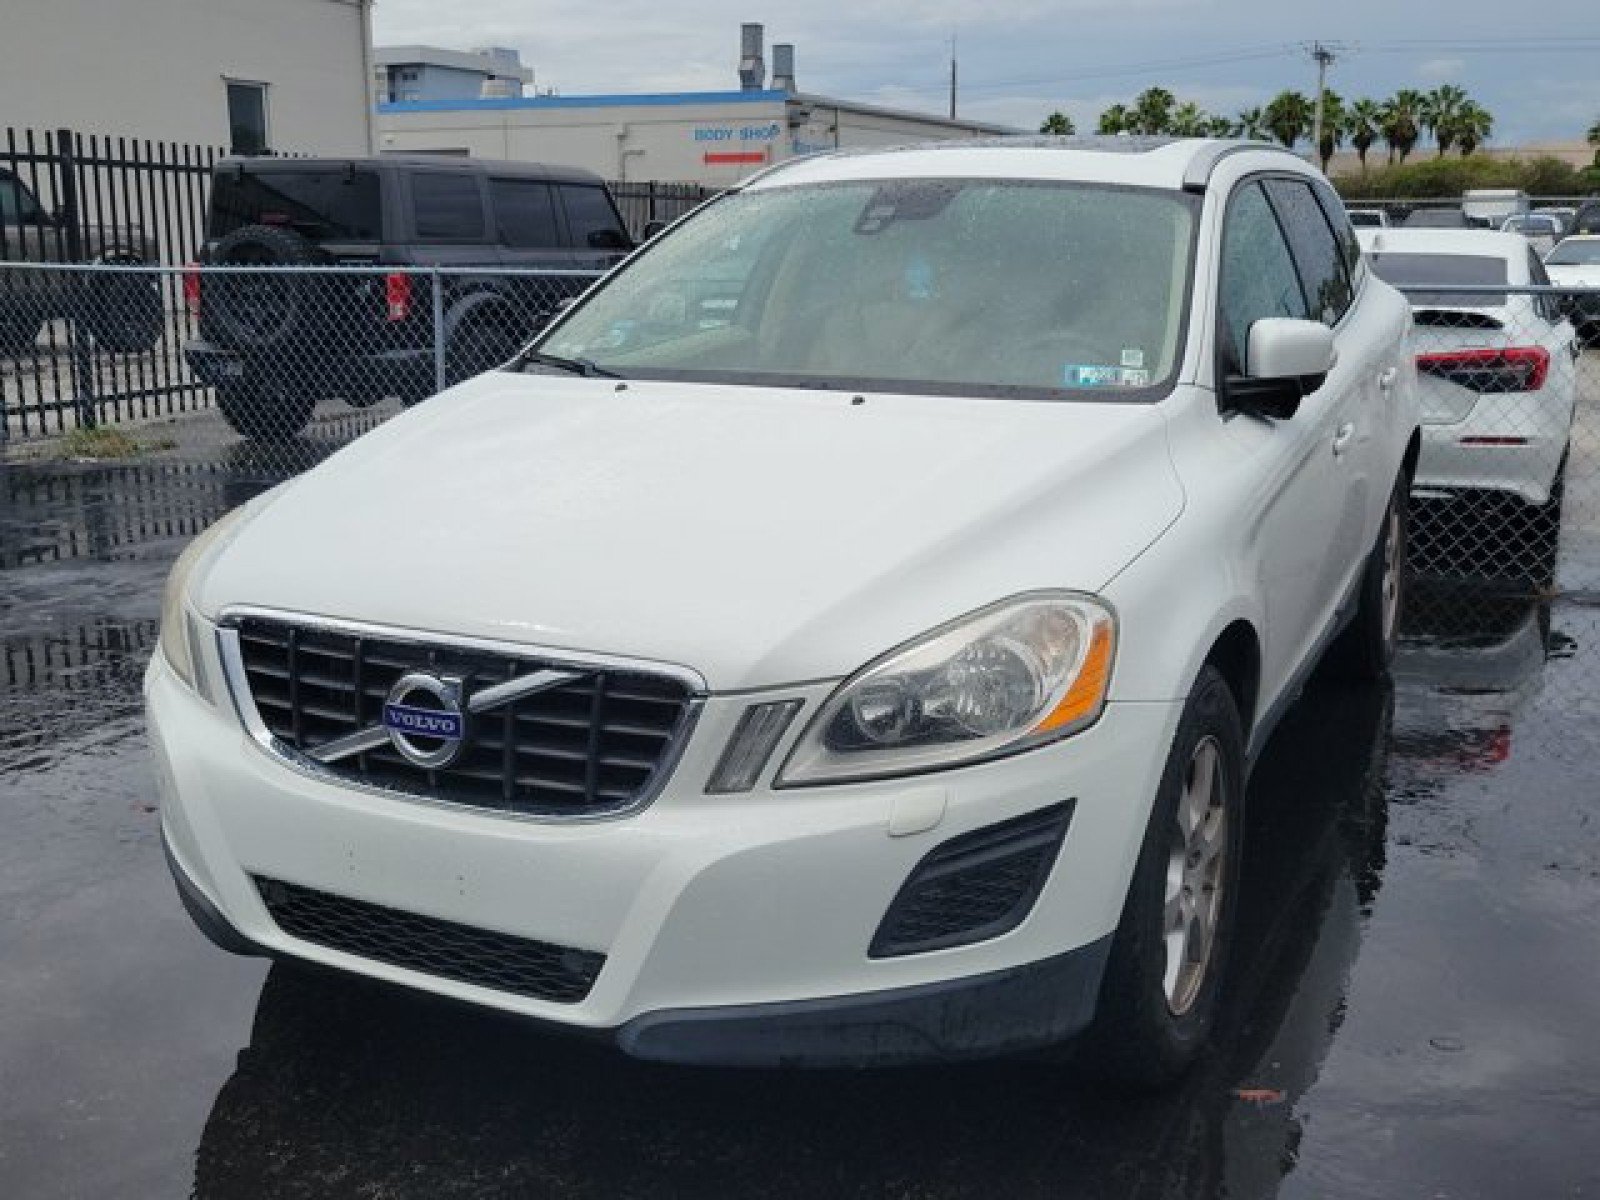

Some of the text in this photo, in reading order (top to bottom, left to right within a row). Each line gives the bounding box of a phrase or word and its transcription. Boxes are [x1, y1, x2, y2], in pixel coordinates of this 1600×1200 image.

[694, 124, 780, 141] BODY SHOP
[388, 709, 456, 732] VOLVO
